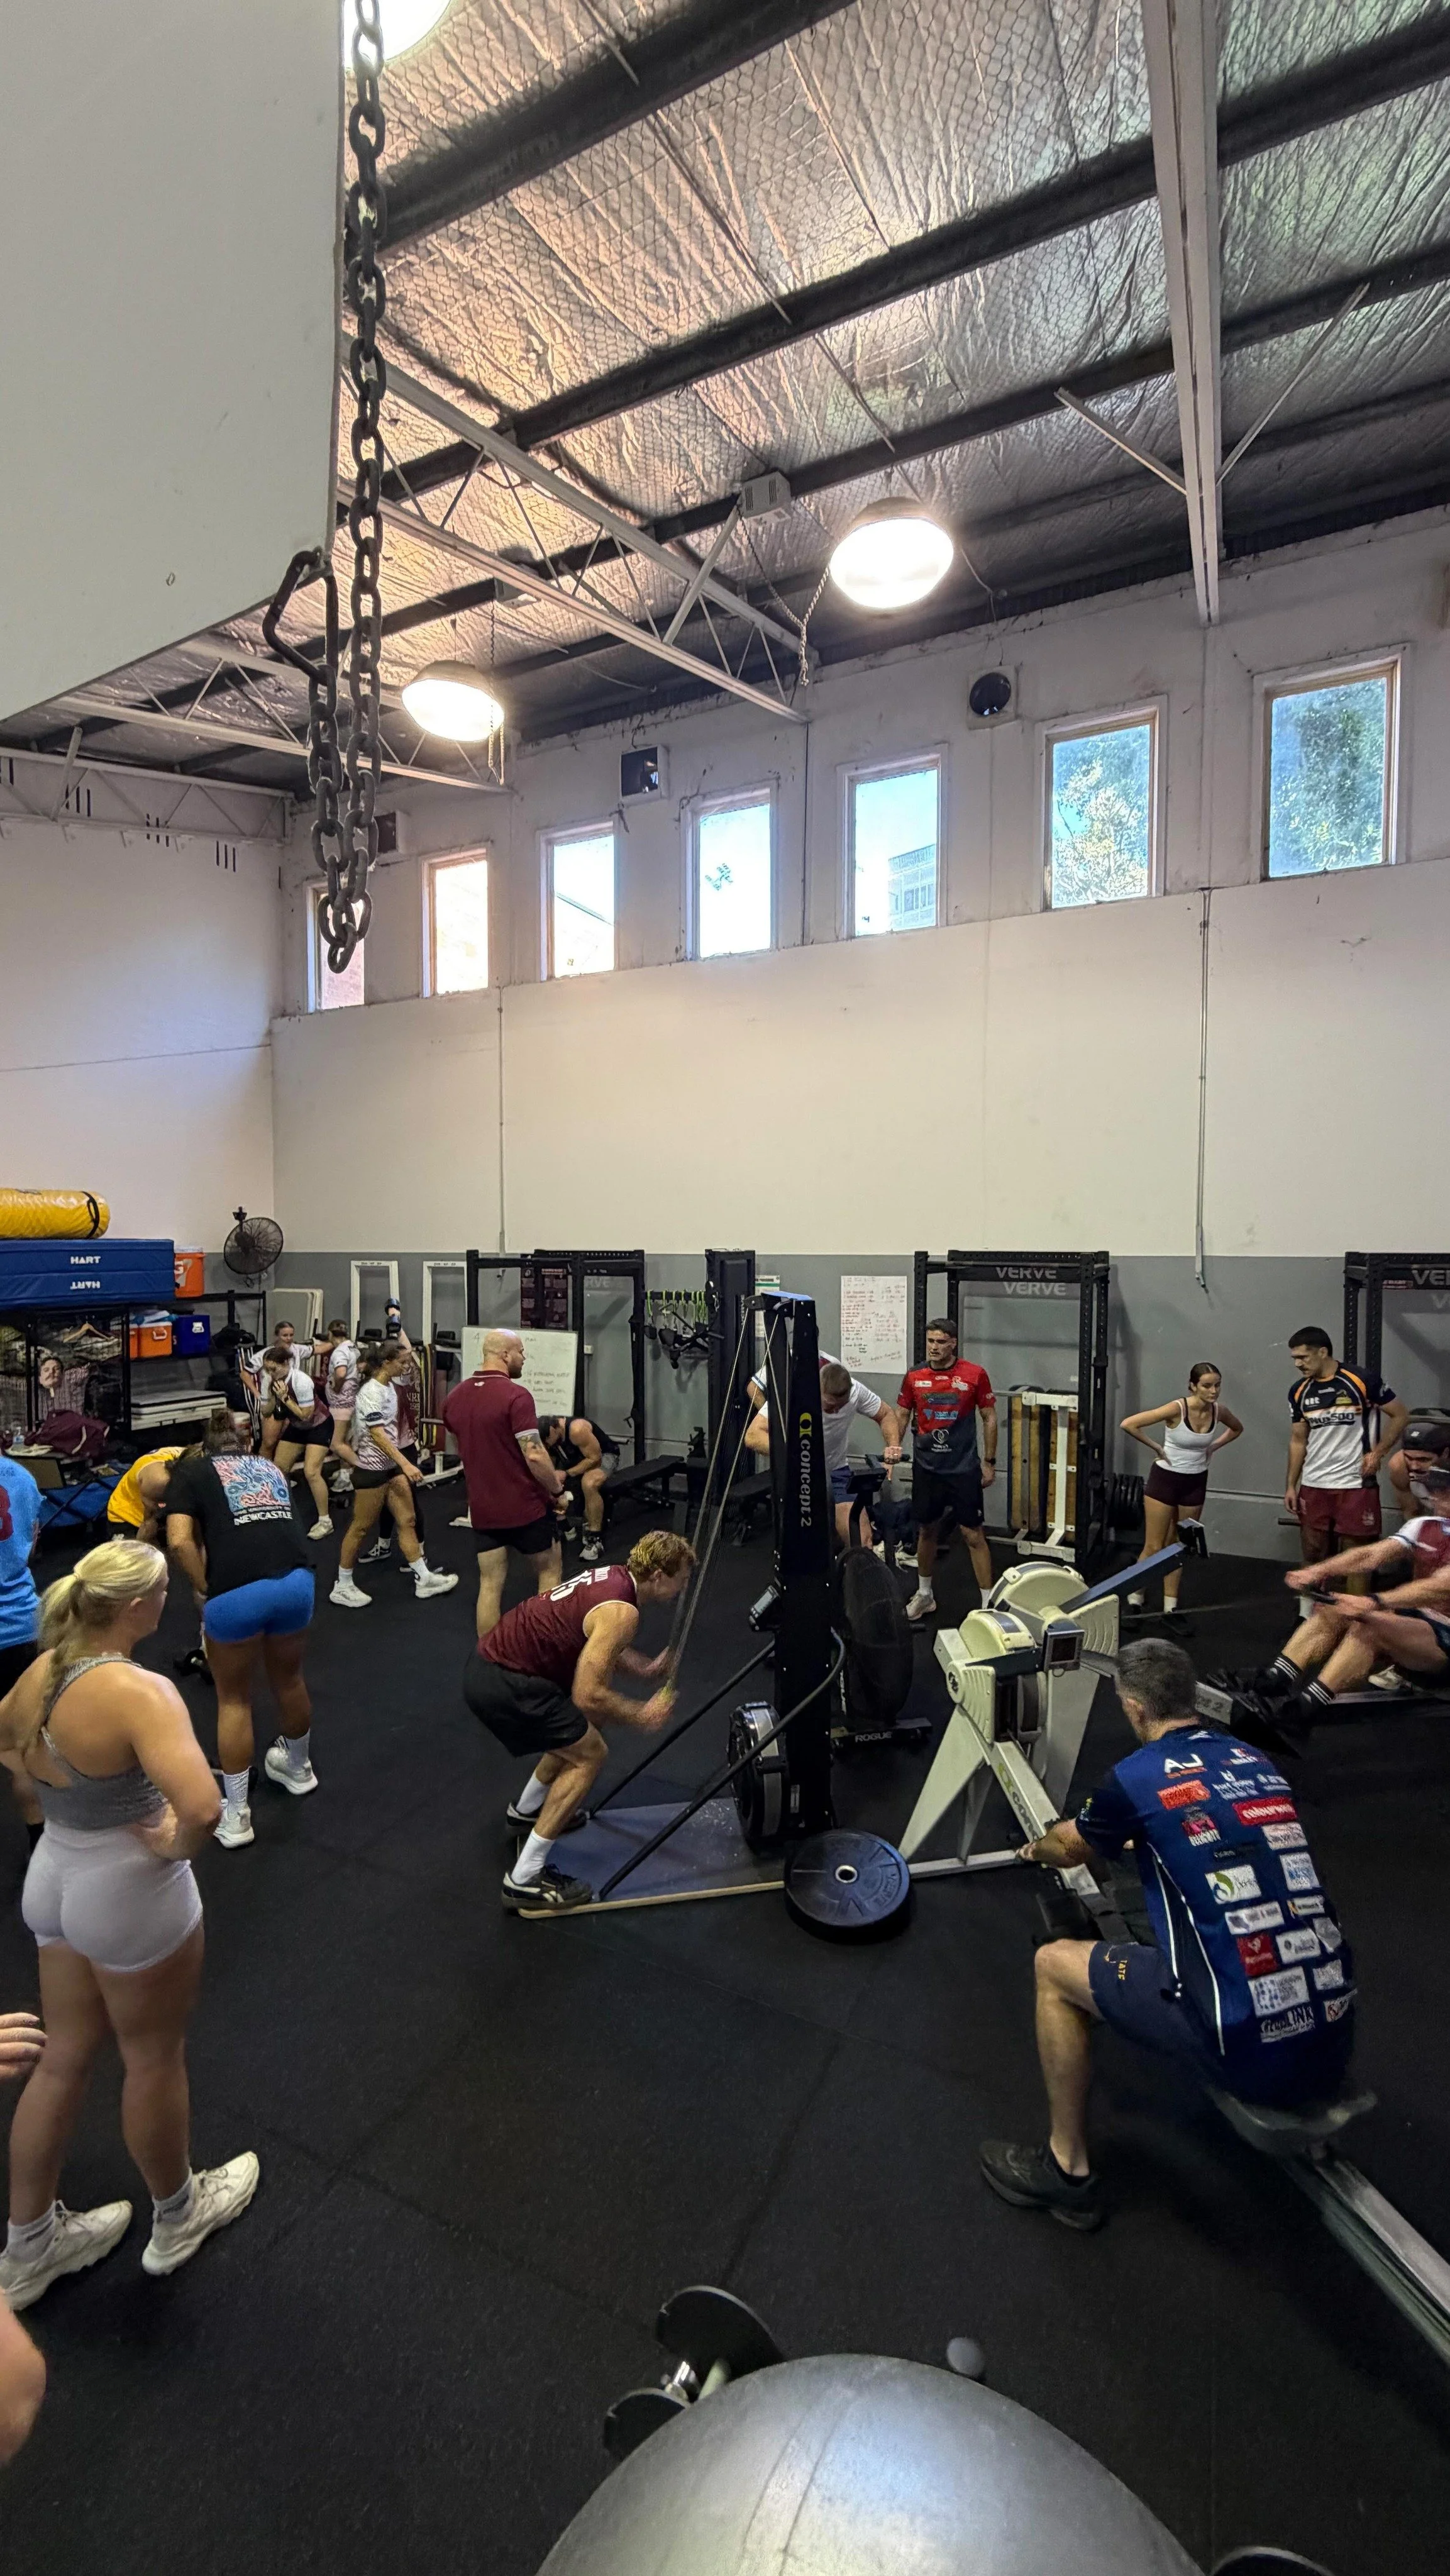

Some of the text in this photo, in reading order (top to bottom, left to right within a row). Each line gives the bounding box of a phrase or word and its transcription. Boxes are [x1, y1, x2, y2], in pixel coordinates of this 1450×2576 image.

[70, 1256, 101, 1264] HART
[996, 1267, 1057, 1279] VERVE
[70, 1281, 101, 1289] HART
[799, 1439, 812, 1528] concept 2
[233, 1511, 293, 1526] NEWCASTLE
[855, 1731, 892, 1743] ROGUE
[1164, 1753, 1204, 1774] AJ
[1117, 1959, 1128, 1981] TATE
